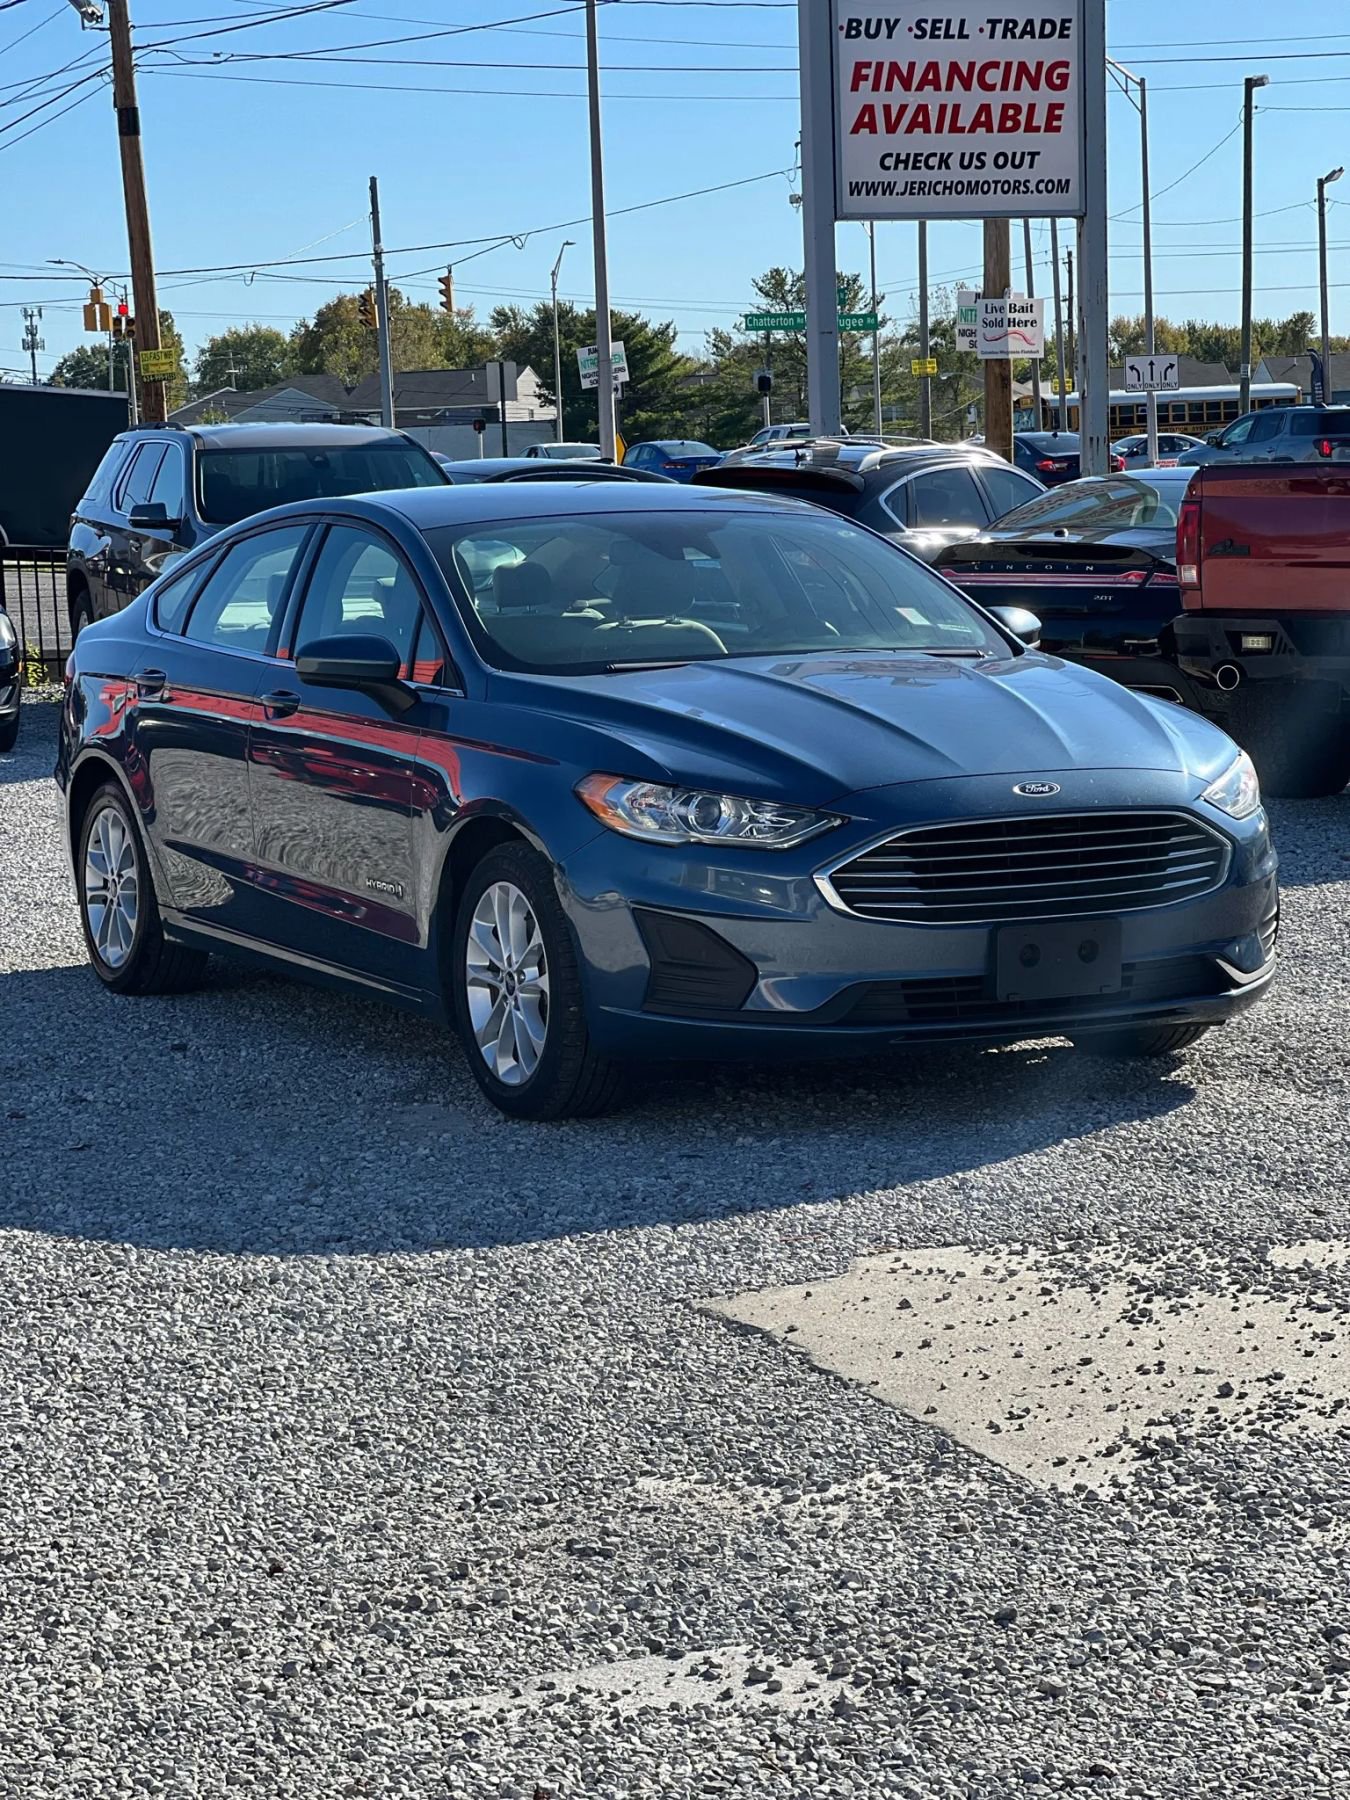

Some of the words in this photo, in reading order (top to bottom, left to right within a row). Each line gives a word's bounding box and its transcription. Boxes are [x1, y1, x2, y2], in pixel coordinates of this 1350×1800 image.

[850, 60, 1071, 92] FINANCING
[850, 102, 1065, 135] AVAILABLE
[879, 152, 953, 171] CHECK
[959, 152, 987, 170] US
[993, 151, 1040, 170] OUT
[849, 178, 1071, 197] WWW.JERICHOMOTORS.COM
[985, 303, 1005, 314] Live
[1008, 302, 1034, 314] Bait
[746, 316, 795, 327] Chatterton
[839, 318, 864, 330] ugee
[982, 317, 1004, 328] Sold
[1007, 317, 1037, 328] Here
[974, 564, 1094, 572] LINCOLN
[366, 878, 395, 894] HYBRID
